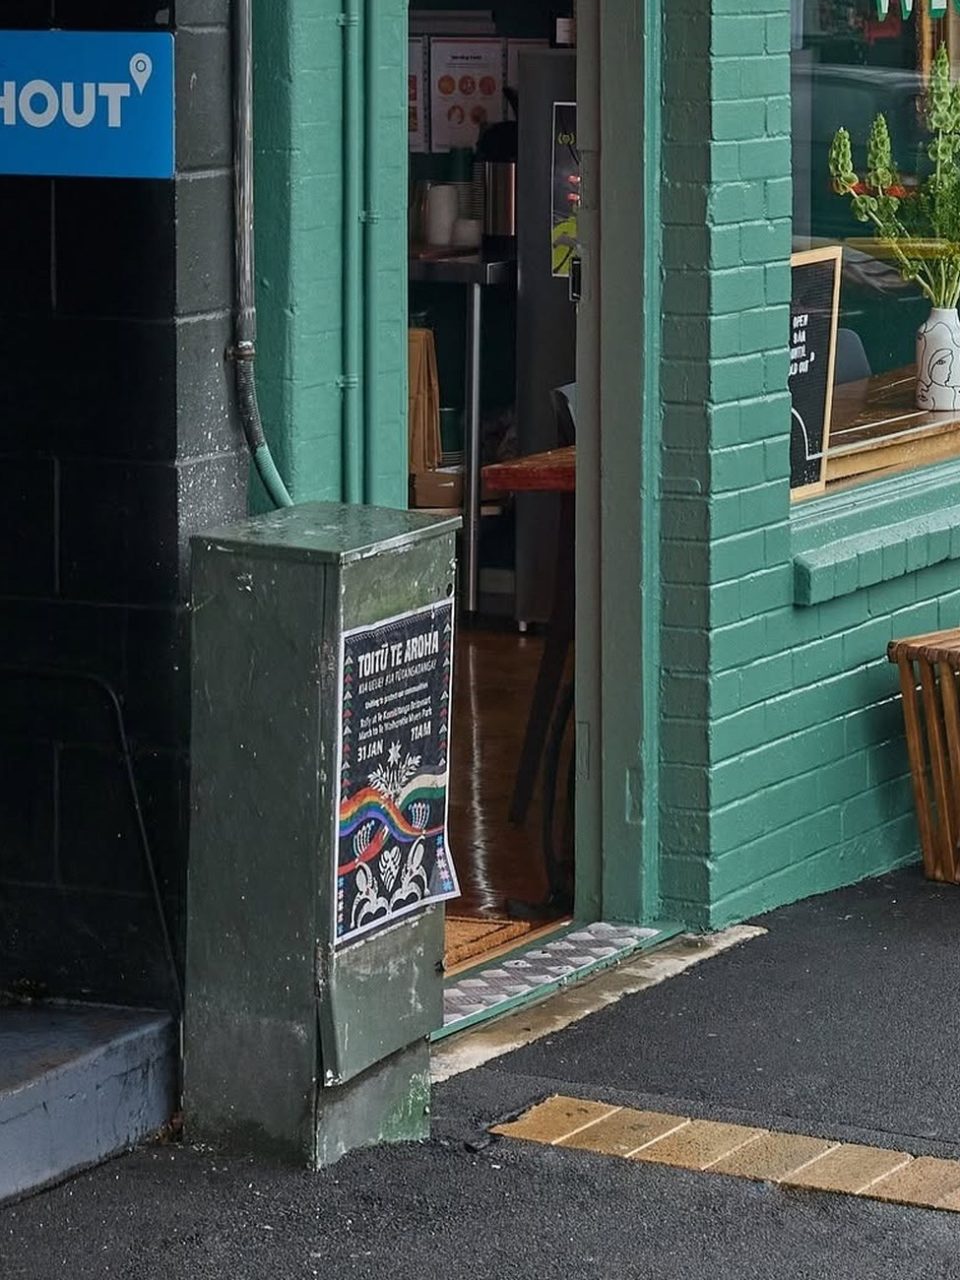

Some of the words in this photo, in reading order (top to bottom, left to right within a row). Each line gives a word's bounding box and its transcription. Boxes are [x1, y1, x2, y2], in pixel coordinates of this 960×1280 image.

[358, 642, 389, 679] TOITŪ
[391, 644, 404, 667] TE
[404, 631, 439, 663] AROHA
[358, 745, 366, 762] 31
[367, 738, 384, 760] JAN
